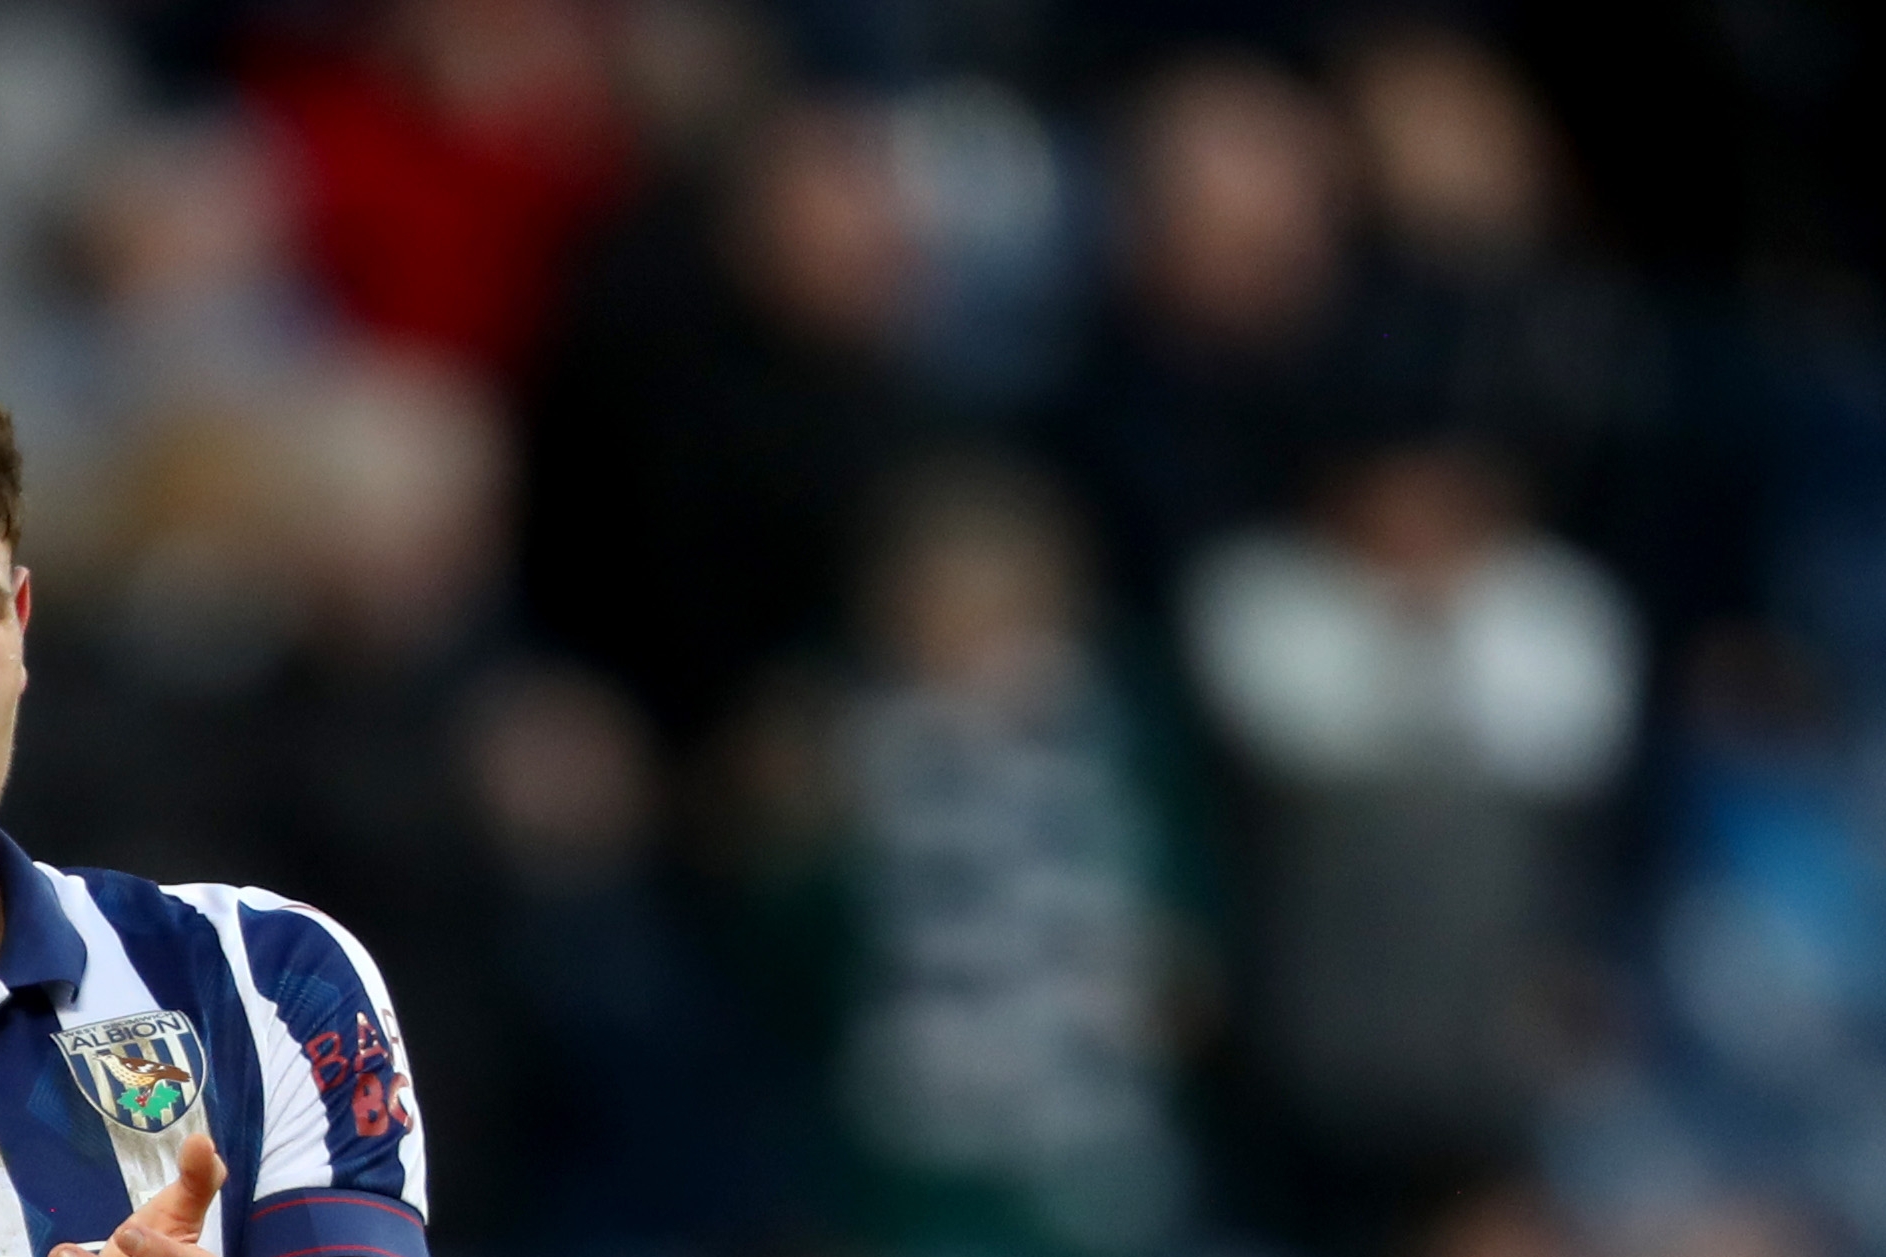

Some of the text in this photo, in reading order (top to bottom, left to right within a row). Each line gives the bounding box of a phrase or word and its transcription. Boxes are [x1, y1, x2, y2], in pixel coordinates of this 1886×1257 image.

[62, 1011, 175, 1038] WEST BROMWICH
[72, 1018, 182, 1051] ALBION
